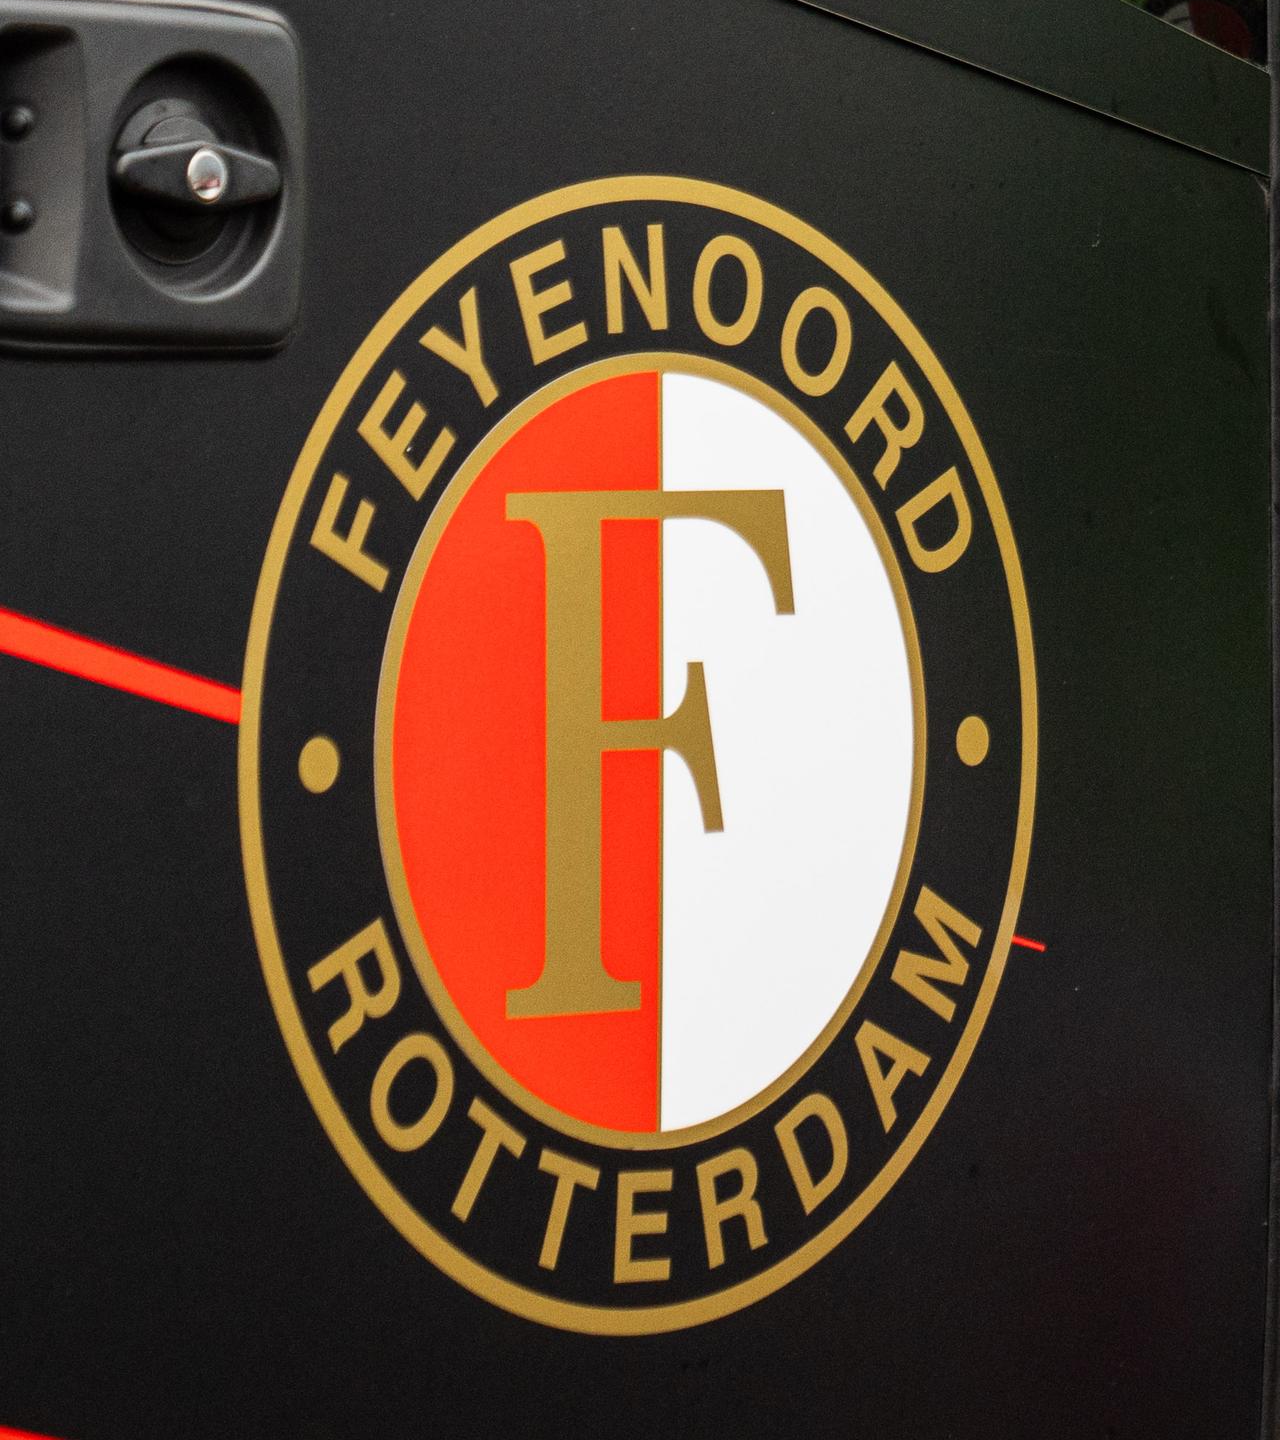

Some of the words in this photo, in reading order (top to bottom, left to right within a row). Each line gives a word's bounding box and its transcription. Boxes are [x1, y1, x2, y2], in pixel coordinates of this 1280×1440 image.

[310, 222, 975, 594] FEYENOORD
[503, 489, 796, 1021] F
[308, 885, 984, 1285] ROTTERDAM
